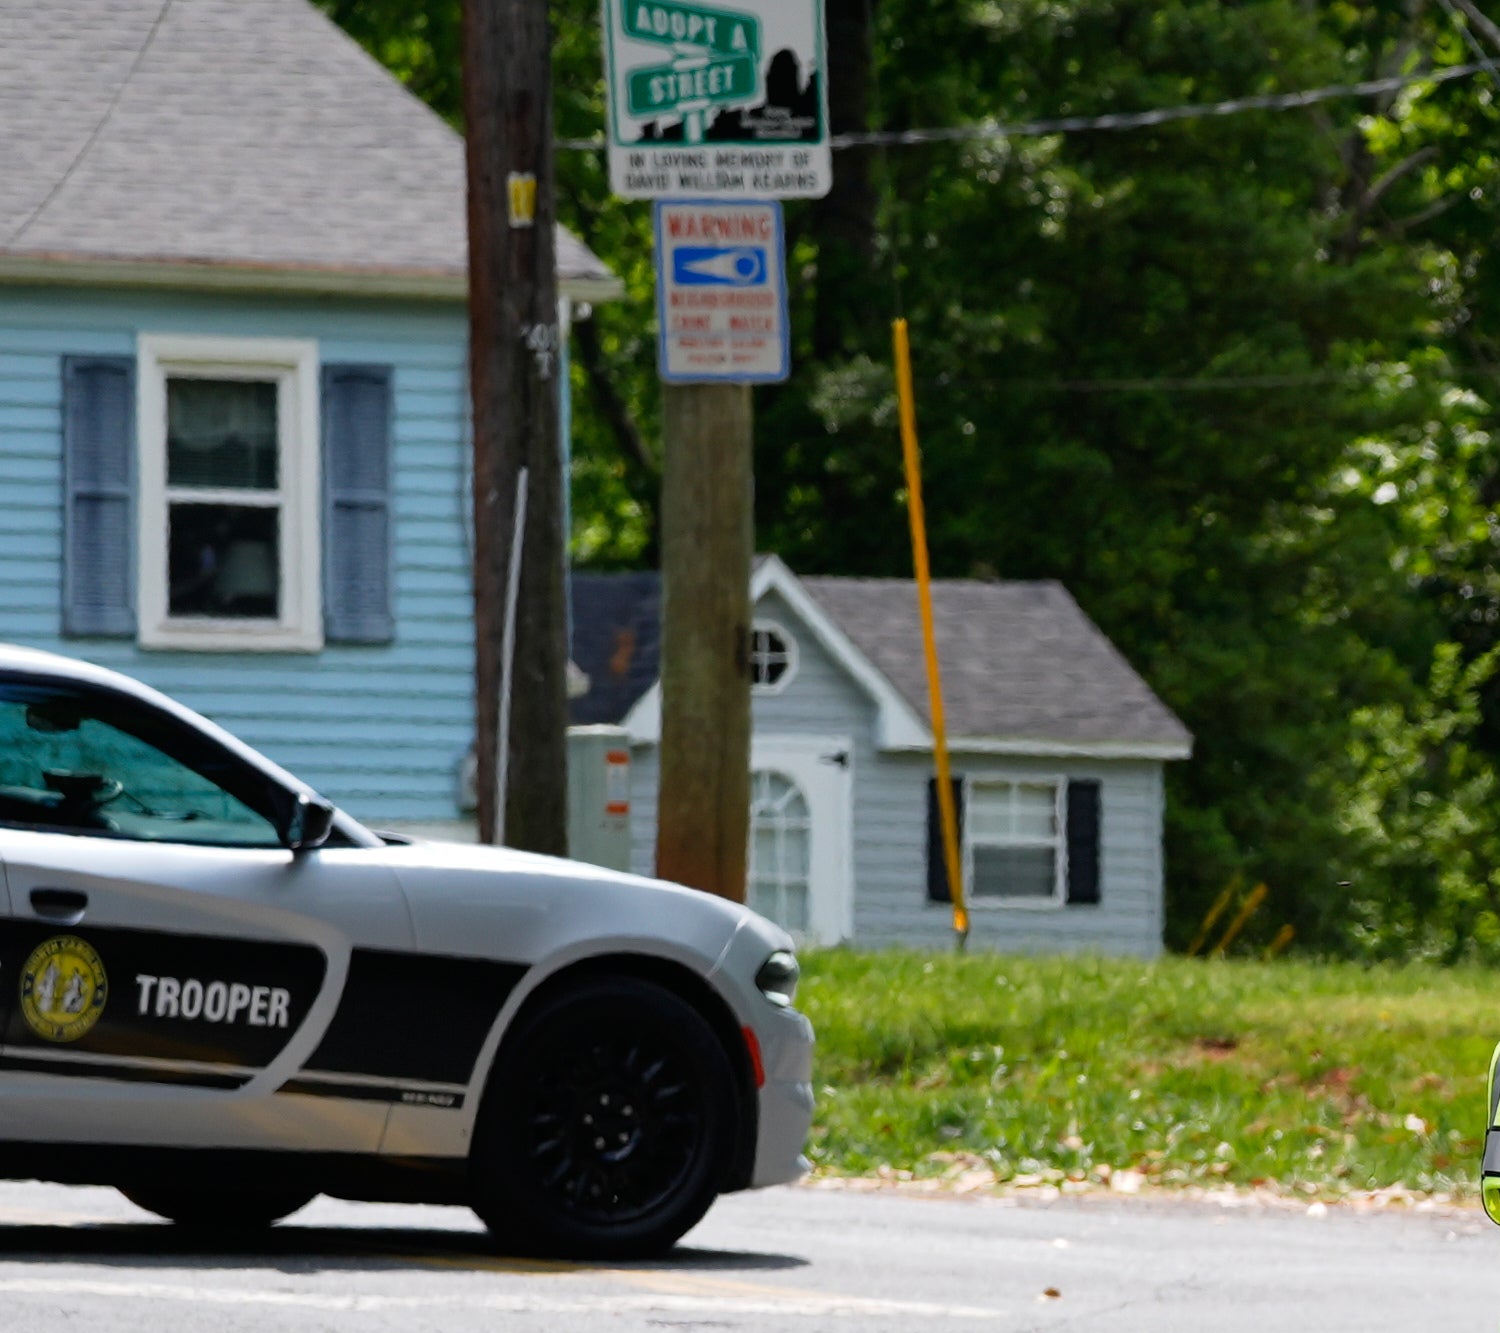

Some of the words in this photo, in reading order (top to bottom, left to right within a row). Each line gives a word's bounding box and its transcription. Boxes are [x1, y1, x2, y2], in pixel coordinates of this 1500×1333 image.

[636, 5, 717, 44] ADOPT
[731, 23, 747, 49] A
[650, 65, 735, 104] STREET
[630, 153, 645, 168] IN
[653, 152, 704, 168] LOVING
[715, 152, 784, 168] MEMORY
[668, 213, 771, 241] WARNING
[136, 973, 290, 1028] TROOPER
